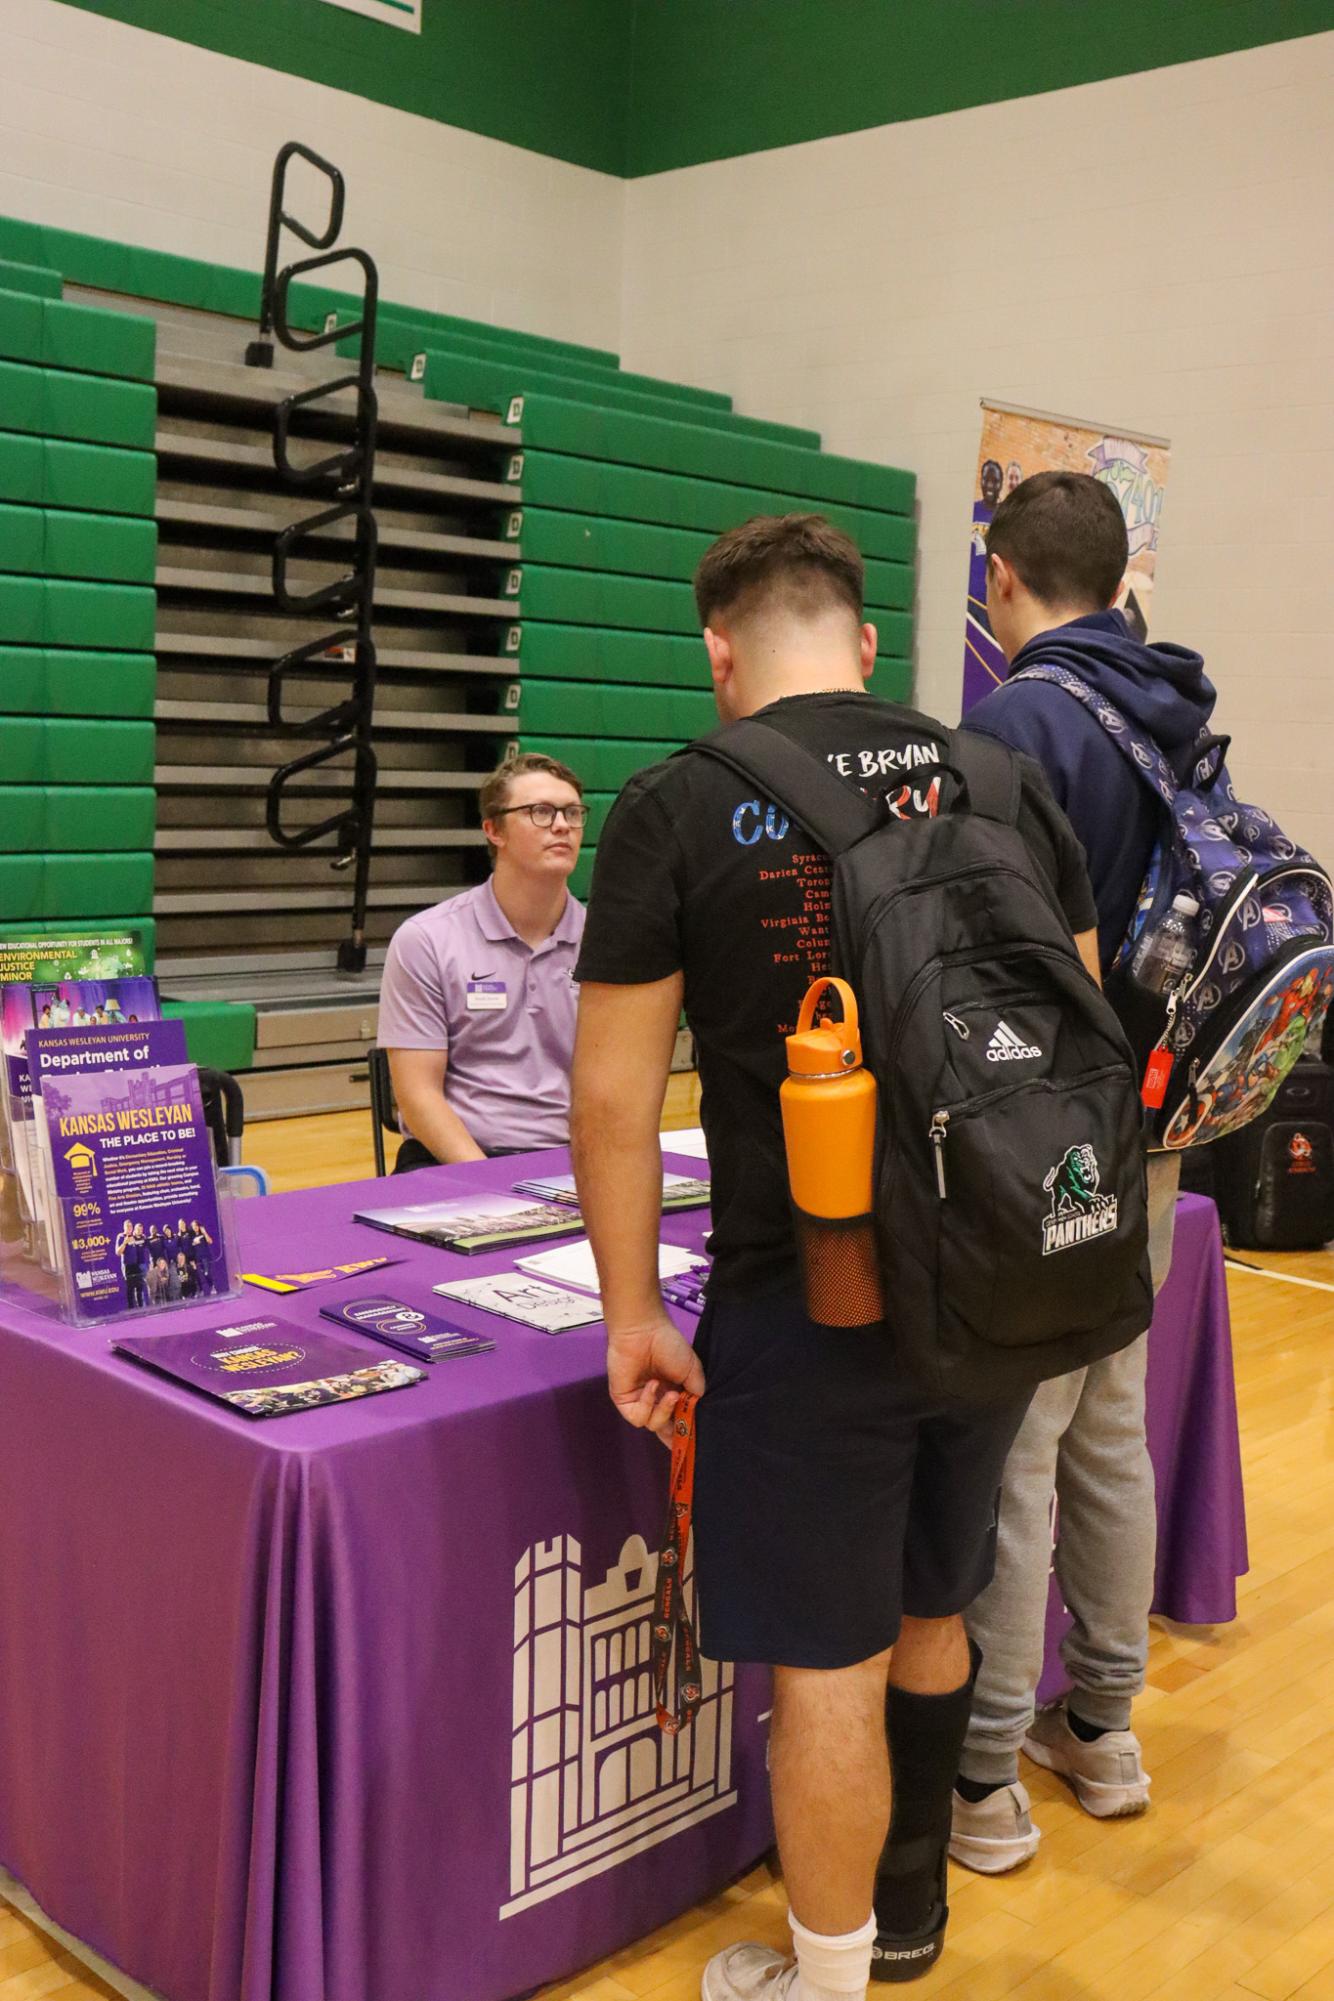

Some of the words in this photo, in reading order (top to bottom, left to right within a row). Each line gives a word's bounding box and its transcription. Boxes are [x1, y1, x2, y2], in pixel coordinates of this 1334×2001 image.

[858, 742, 940, 778] BRYAN
[760, 916, 809, 929] Virginia
[0, 950, 77, 961] ENVIRONMENTAL
[773, 952, 800, 964] Fort
[0, 972, 33, 981] MINOR
[38, 1038, 68, 1048] KANSAS
[68, 1036, 107, 1046] WESLEYAN
[108, 1032, 150, 1043] UNIVERSITY
[40, 1048, 130, 1069] Department
[134, 1045, 150, 1060] of
[986, 1045, 1042, 1062] adidas
[59, 1111, 116, 1137] KANSAS
[117, 1103, 193, 1131] WESLEYAN
[100, 1136, 122, 1149] THE
[123, 1132, 159, 1146] PLACE
[162, 1129, 177, 1142] TO
[178, 1127, 196, 1140] BE!
[73, 1202, 101, 1217] 99%
[1046, 1203, 1117, 1251] PANTHERS
[492, 1284, 560, 1303] Art
[883, 1942, 935, 1960] BREG
